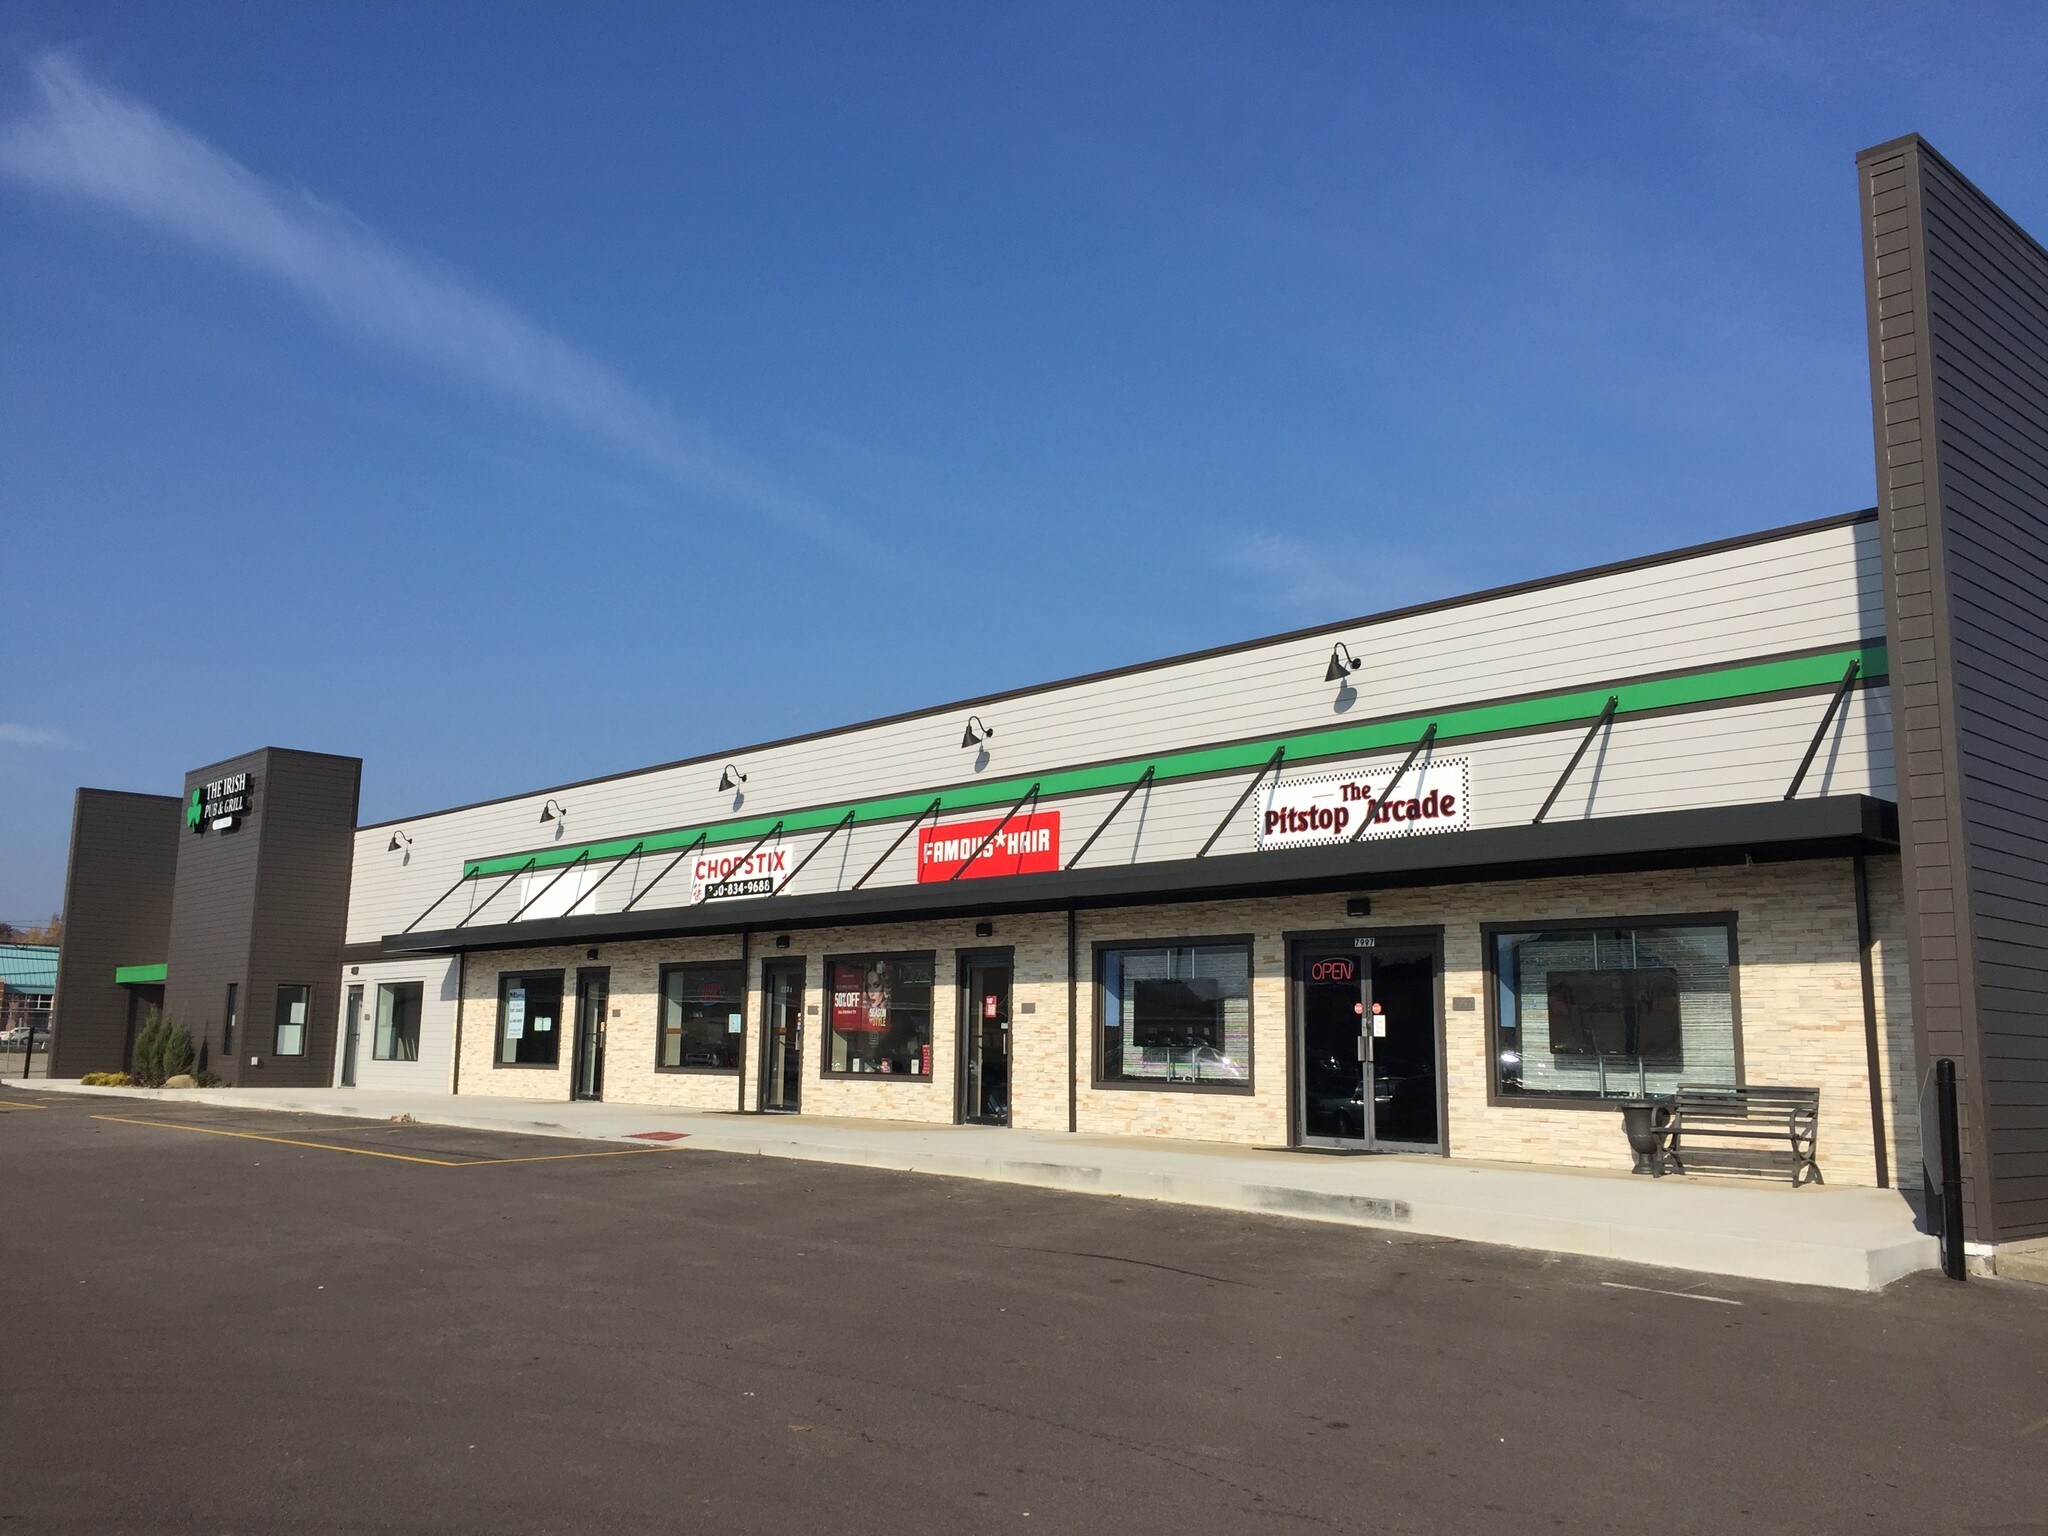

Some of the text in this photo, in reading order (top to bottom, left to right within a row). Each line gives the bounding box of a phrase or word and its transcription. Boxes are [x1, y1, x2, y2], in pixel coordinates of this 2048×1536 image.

[206, 773, 246, 800] THE IRISH
[1339, 782, 1372, 802] The
[204, 796, 243, 818] PUB & GRILL
[1264, 804, 1349, 835] Pitstop
[923, 828, 1050, 864] FAMOUS HAIR
[695, 851, 786, 880] CHOPSTIX
[1355, 938, 1375, 947] 7997
[1312, 963, 1352, 980] OPEN
[846, 992, 860, 1007] OFF
